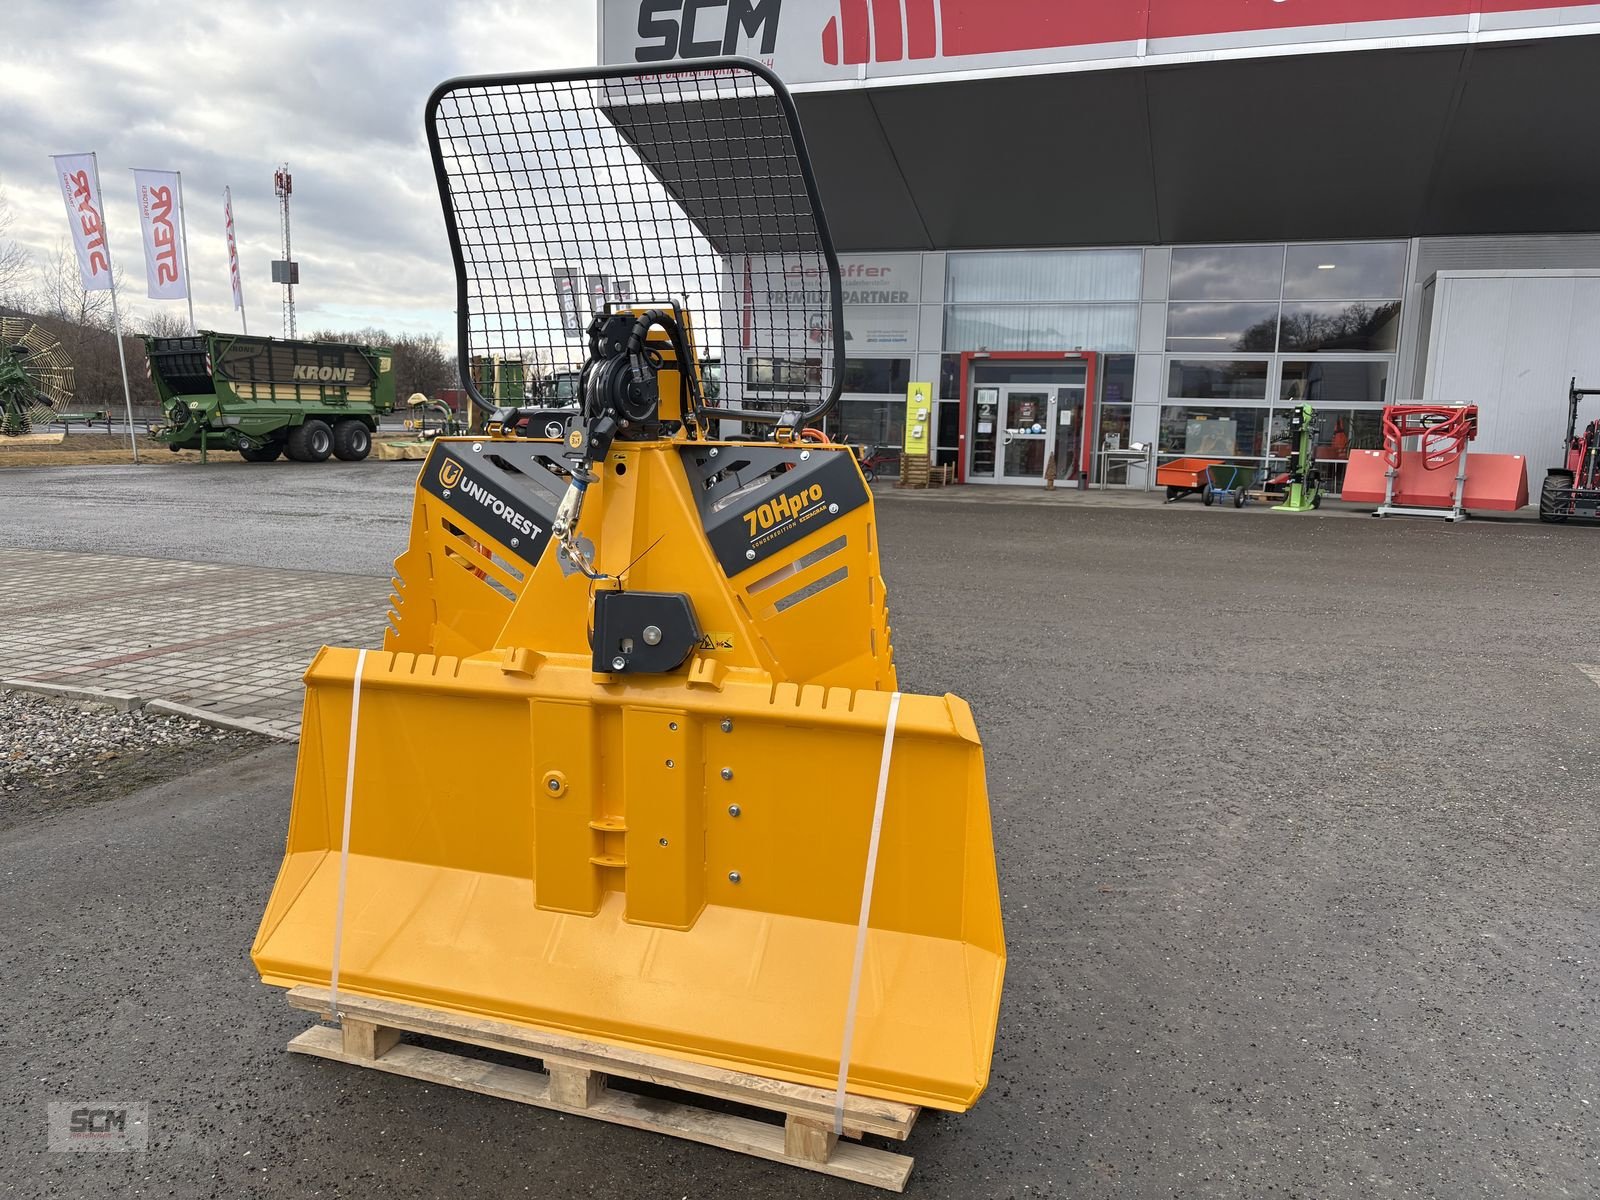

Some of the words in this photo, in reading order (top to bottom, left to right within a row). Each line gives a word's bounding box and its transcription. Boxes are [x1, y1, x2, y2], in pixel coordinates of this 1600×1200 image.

[635, 0, 782, 62] SCM
[765, 290, 833, 304] PREMIU
[843, 290, 909, 303] PARTNER
[293, 365, 356, 382] KRONE
[460, 476, 543, 540] UNIFOREST
[743, 483, 823, 537] 70Hpro
[751, 522, 797, 549] SONDEREDITION
